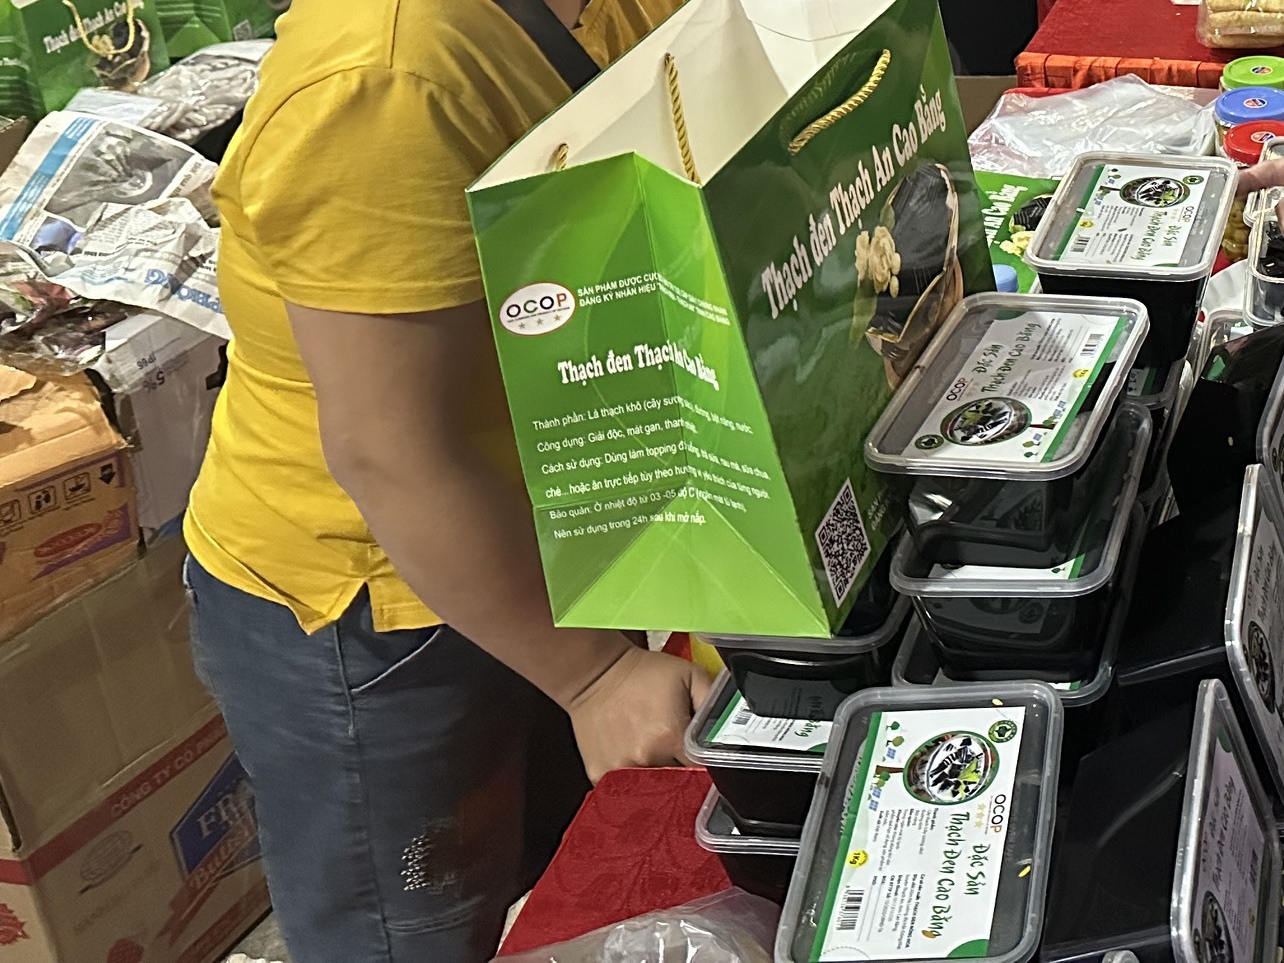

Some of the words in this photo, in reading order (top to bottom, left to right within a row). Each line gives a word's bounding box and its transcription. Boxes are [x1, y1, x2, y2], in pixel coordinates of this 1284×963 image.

[761, 235, 813, 321] Thạch
[809, 213, 837, 267] đen
[829, 158, 875, 237] Thạch
[871, 144, 896, 192] An
[892, 123, 919, 167] Cao
[914, 83, 947, 146] Bằng
[618, 275, 643, 289] ĐƯỢC
[638, 283, 657, 299] HIỆU
[506, 292, 568, 318] OCOP
[558, 353, 604, 386] Thạch
[606, 349, 634, 373] đen
[946, 377, 967, 401] OCOP
[533, 418, 561, 431] Thành
[600, 405, 625, 419] thạch
[643, 397, 662, 412] (cây
[537, 439, 562, 453] Công
[541, 463, 565, 476] Cách
[604, 450, 628, 464] Dùng
[629, 446, 645, 459] làm
[646, 443, 677, 458] topping
[569, 482, 592, 497] hoặc
[603, 477, 622, 490] trực
[622, 471, 639, 486] tiếp
[639, 470, 654, 483] tùy
[654, 467, 674, 480] theo
[550, 509, 568, 520] Bảo
[604, 497, 626, 511] nhiệt
[626, 495, 639, 508] độ
[650, 492, 662, 503] 03
[662, 489, 677, 501] -05
[688, 486, 696, 498] C
[554, 527, 573, 540] Nên
[586, 523, 608, 537] dụng
[609, 519, 632, 532] trong
[632, 516, 649, 528] 24h
[988, 793, 1007, 833] OCOP
[941, 811, 970, 846] Thạch
[848, 851, 861, 865] 1Kg
[937, 847, 962, 874] Đen
[964, 843, 990, 868] Đặc
[934, 876, 956, 901] Cao
[961, 870, 986, 896] Sản
